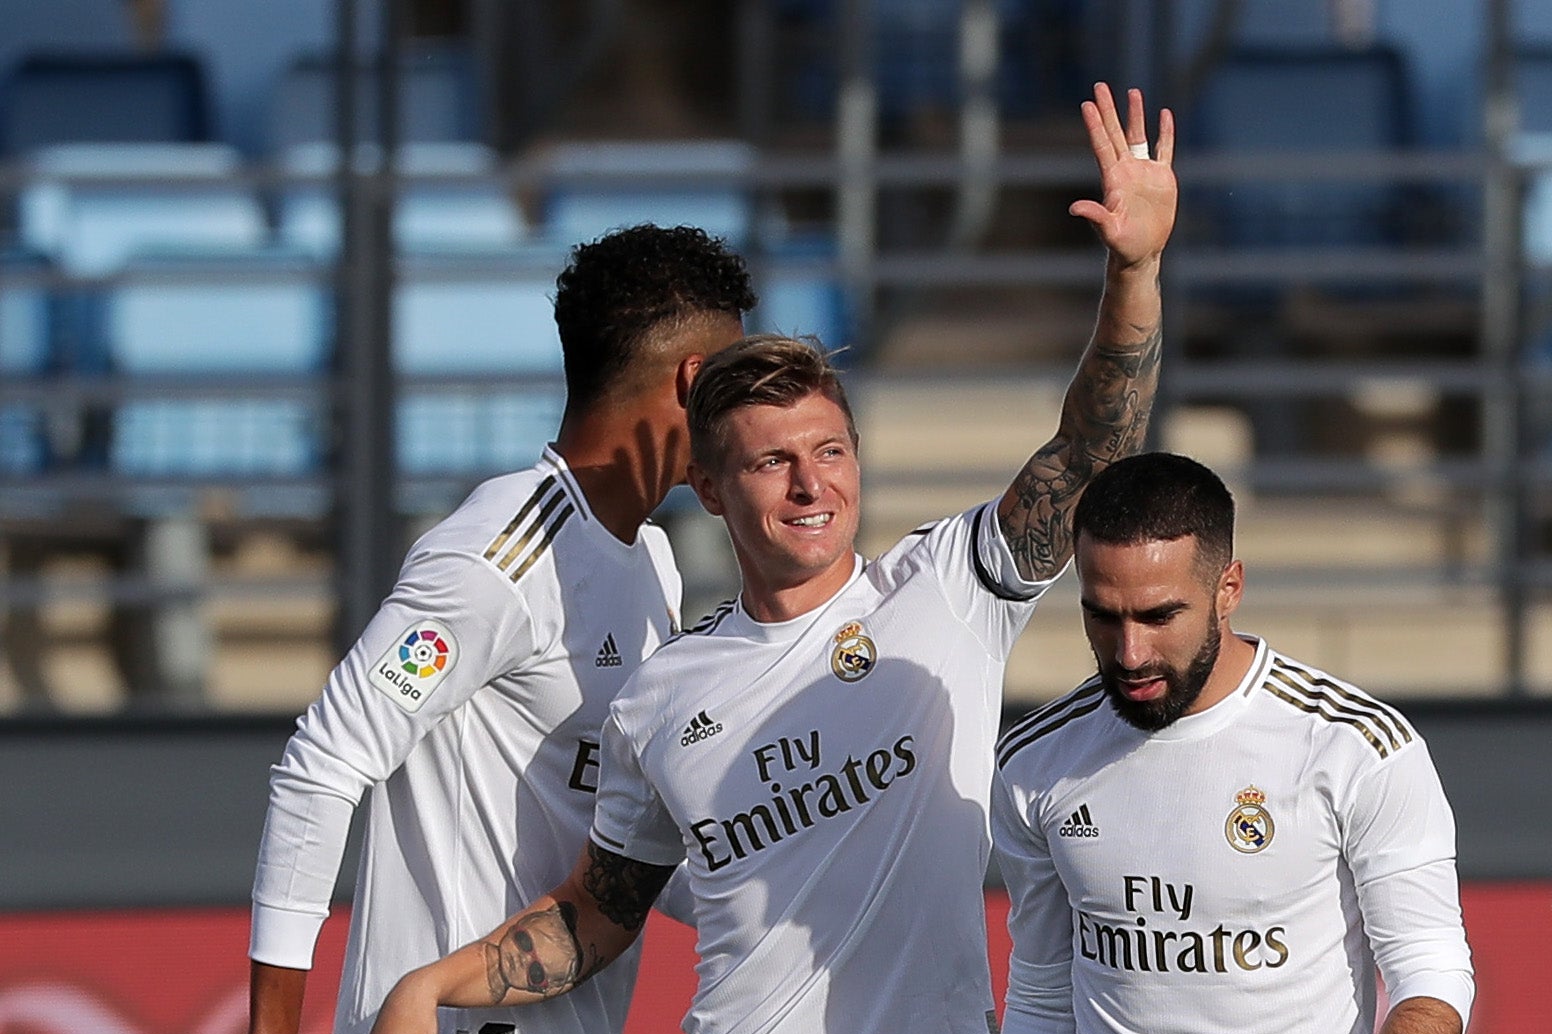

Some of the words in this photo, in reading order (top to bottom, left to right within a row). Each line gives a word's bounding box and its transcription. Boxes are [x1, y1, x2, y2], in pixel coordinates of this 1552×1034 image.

[378, 662, 422, 701] LaLiga
[595, 654, 622, 667] adidas
[680, 723, 723, 747] adidas
[753, 730, 820, 783] Fly
[690, 735, 916, 872] Emirates
[1059, 824, 1099, 838] adidas
[1123, 875, 1193, 920] Fly
[1079, 911, 1289, 974] Emirates
